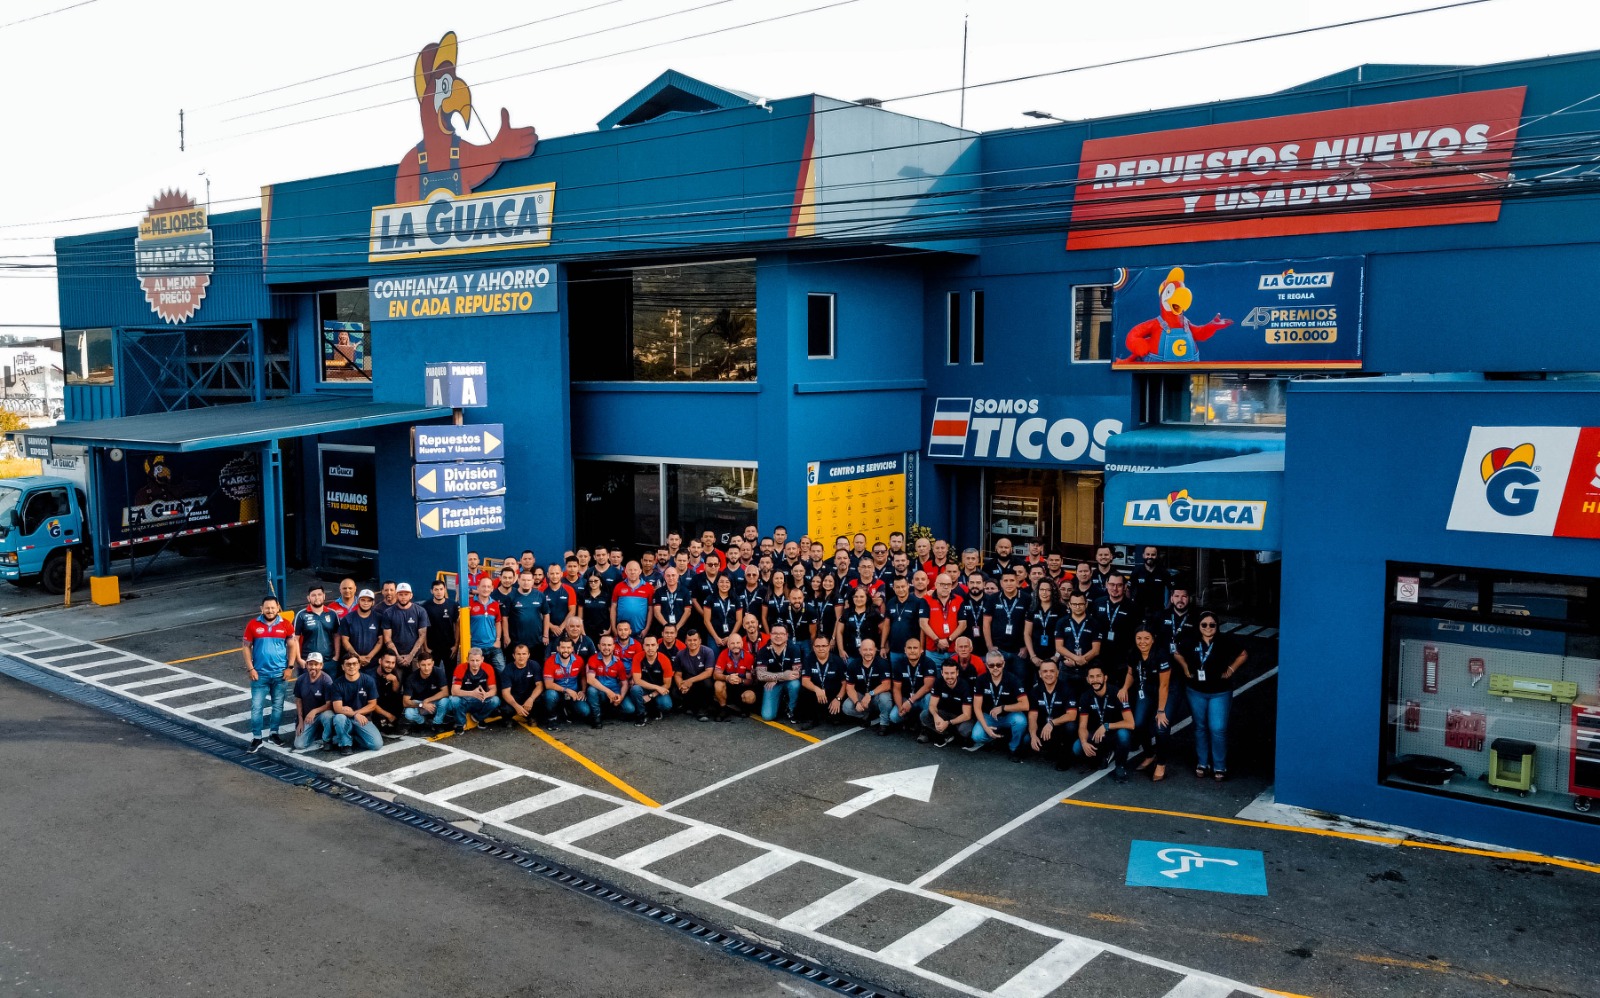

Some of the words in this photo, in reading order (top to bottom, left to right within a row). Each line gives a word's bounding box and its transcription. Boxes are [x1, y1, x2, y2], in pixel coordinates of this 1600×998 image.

[1092, 143, 1300, 190] REPUESTOS
[1311, 122, 1490, 170] NUEVOS
[1180, 189, 1206, 214] Y
[1214, 173, 1373, 212] USADOS
[151, 210, 204, 236] MEJORES
[380, 212, 416, 250] LA
[426, 196, 540, 245] GUACA
[140, 242, 210, 272] MARCAS
[154, 278, 165, 292] AL
[166, 276, 196, 290] MEJOR
[374, 275, 458, 299] CONFIANZA
[464, 274, 475, 292] Y
[476, 267, 550, 292] AHORRO
[1263, 277, 1279, 286] LA
[1284, 274, 1328, 286] GUACA
[160, 290, 191, 304] PRECIO
[388, 300, 408, 318] EN
[411, 297, 450, 317] CADA
[455, 291, 533, 314] REPUESTO
[1241, 306, 1271, 330] 45
[1271, 308, 1337, 321] PREMIOS
[426, 366, 447, 377] PARQUEO
[452, 366, 484, 376] PARQUEO
[432, 378, 443, 405] A
[461, 378, 477, 405] A
[974, 398, 1039, 414] SOMOS
[419, 434, 481, 447] Repuestos
[971, 418, 1124, 462] TICOS
[444, 467, 497, 480] División
[830, 465, 854, 477] CENTRO
[856, 464, 865, 473] DE
[866, 460, 896, 472] SERVICIOS
[444, 480, 497, 492] Motores
[1486, 468, 1541, 516] G
[327, 491, 368, 505] LLEVAMOS
[341, 504, 367, 512] REPUESTOS
[442, 505, 502, 518] Parabrisas
[1132, 504, 1161, 521] LA
[1169, 499, 1254, 524] GUACA
[443, 515, 502, 529] Instalación
